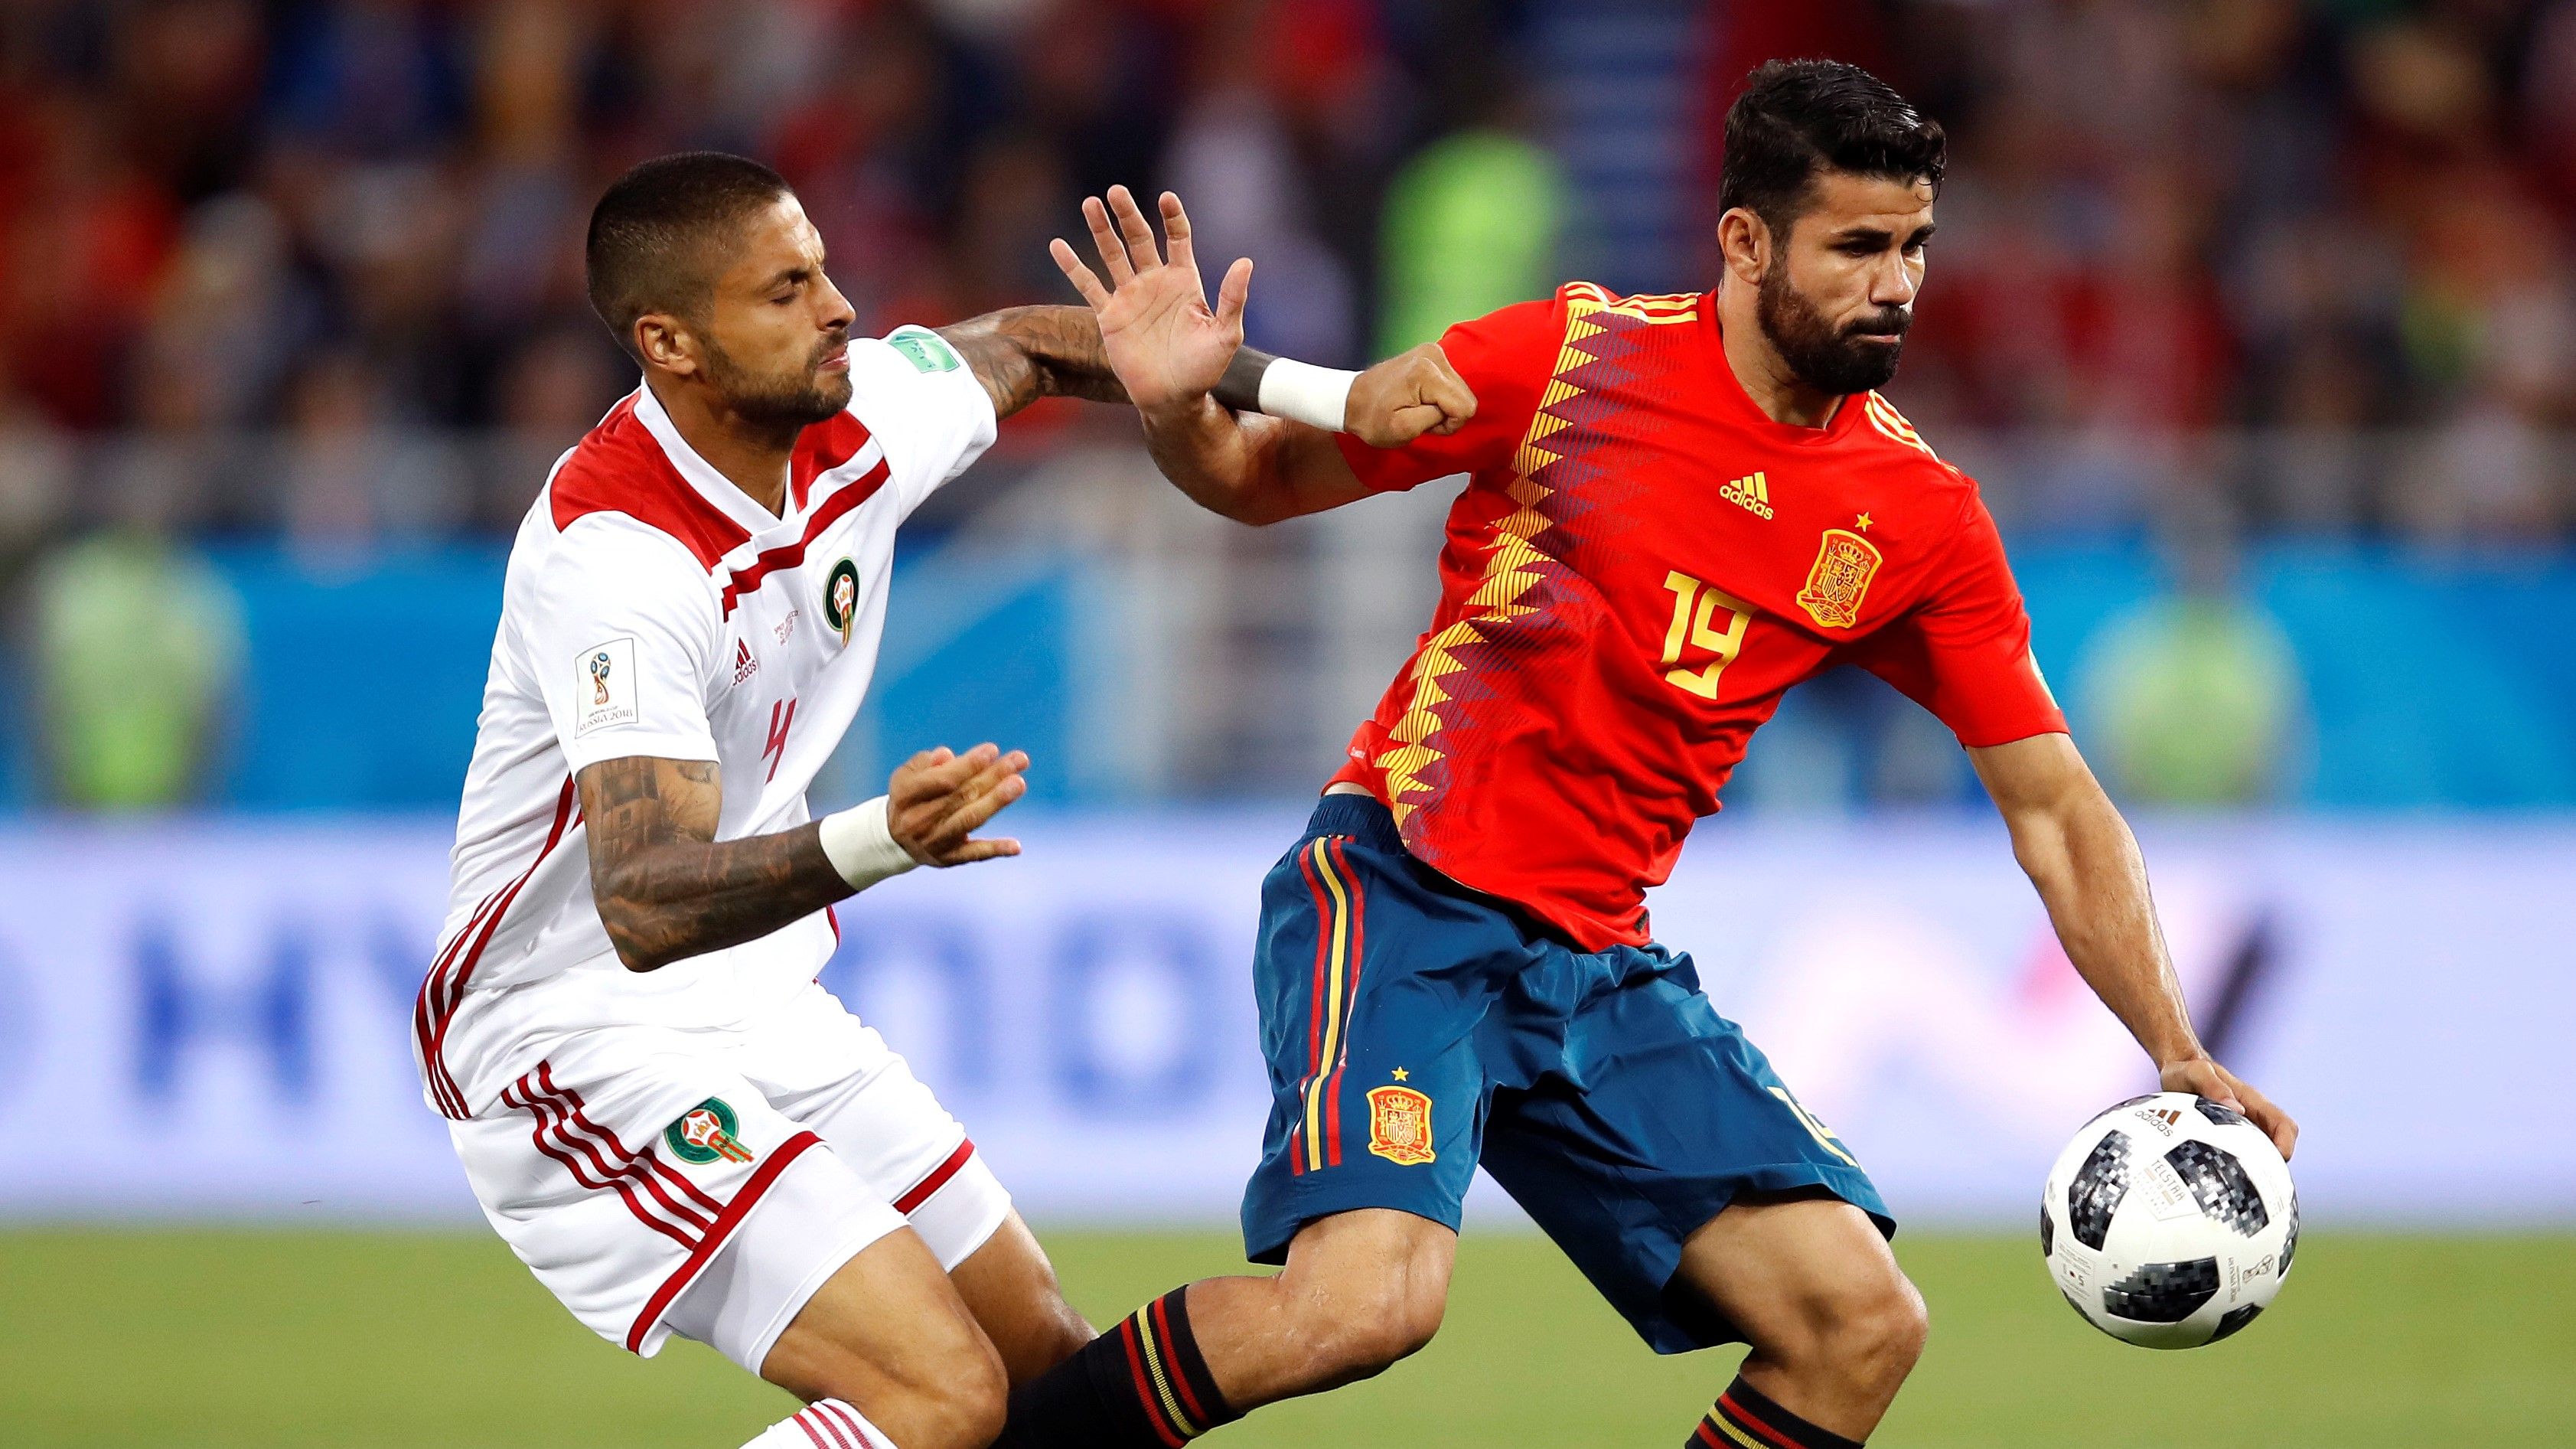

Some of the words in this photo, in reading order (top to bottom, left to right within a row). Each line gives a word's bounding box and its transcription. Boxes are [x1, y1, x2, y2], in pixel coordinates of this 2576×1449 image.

[1719, 484, 1775, 521] adidas
[1660, 569, 1759, 700] 19
[761, 697, 797, 785] 4
[2135, 1110, 2173, 1137] adidas
[2151, 1159, 2186, 1201] TELSTAR
